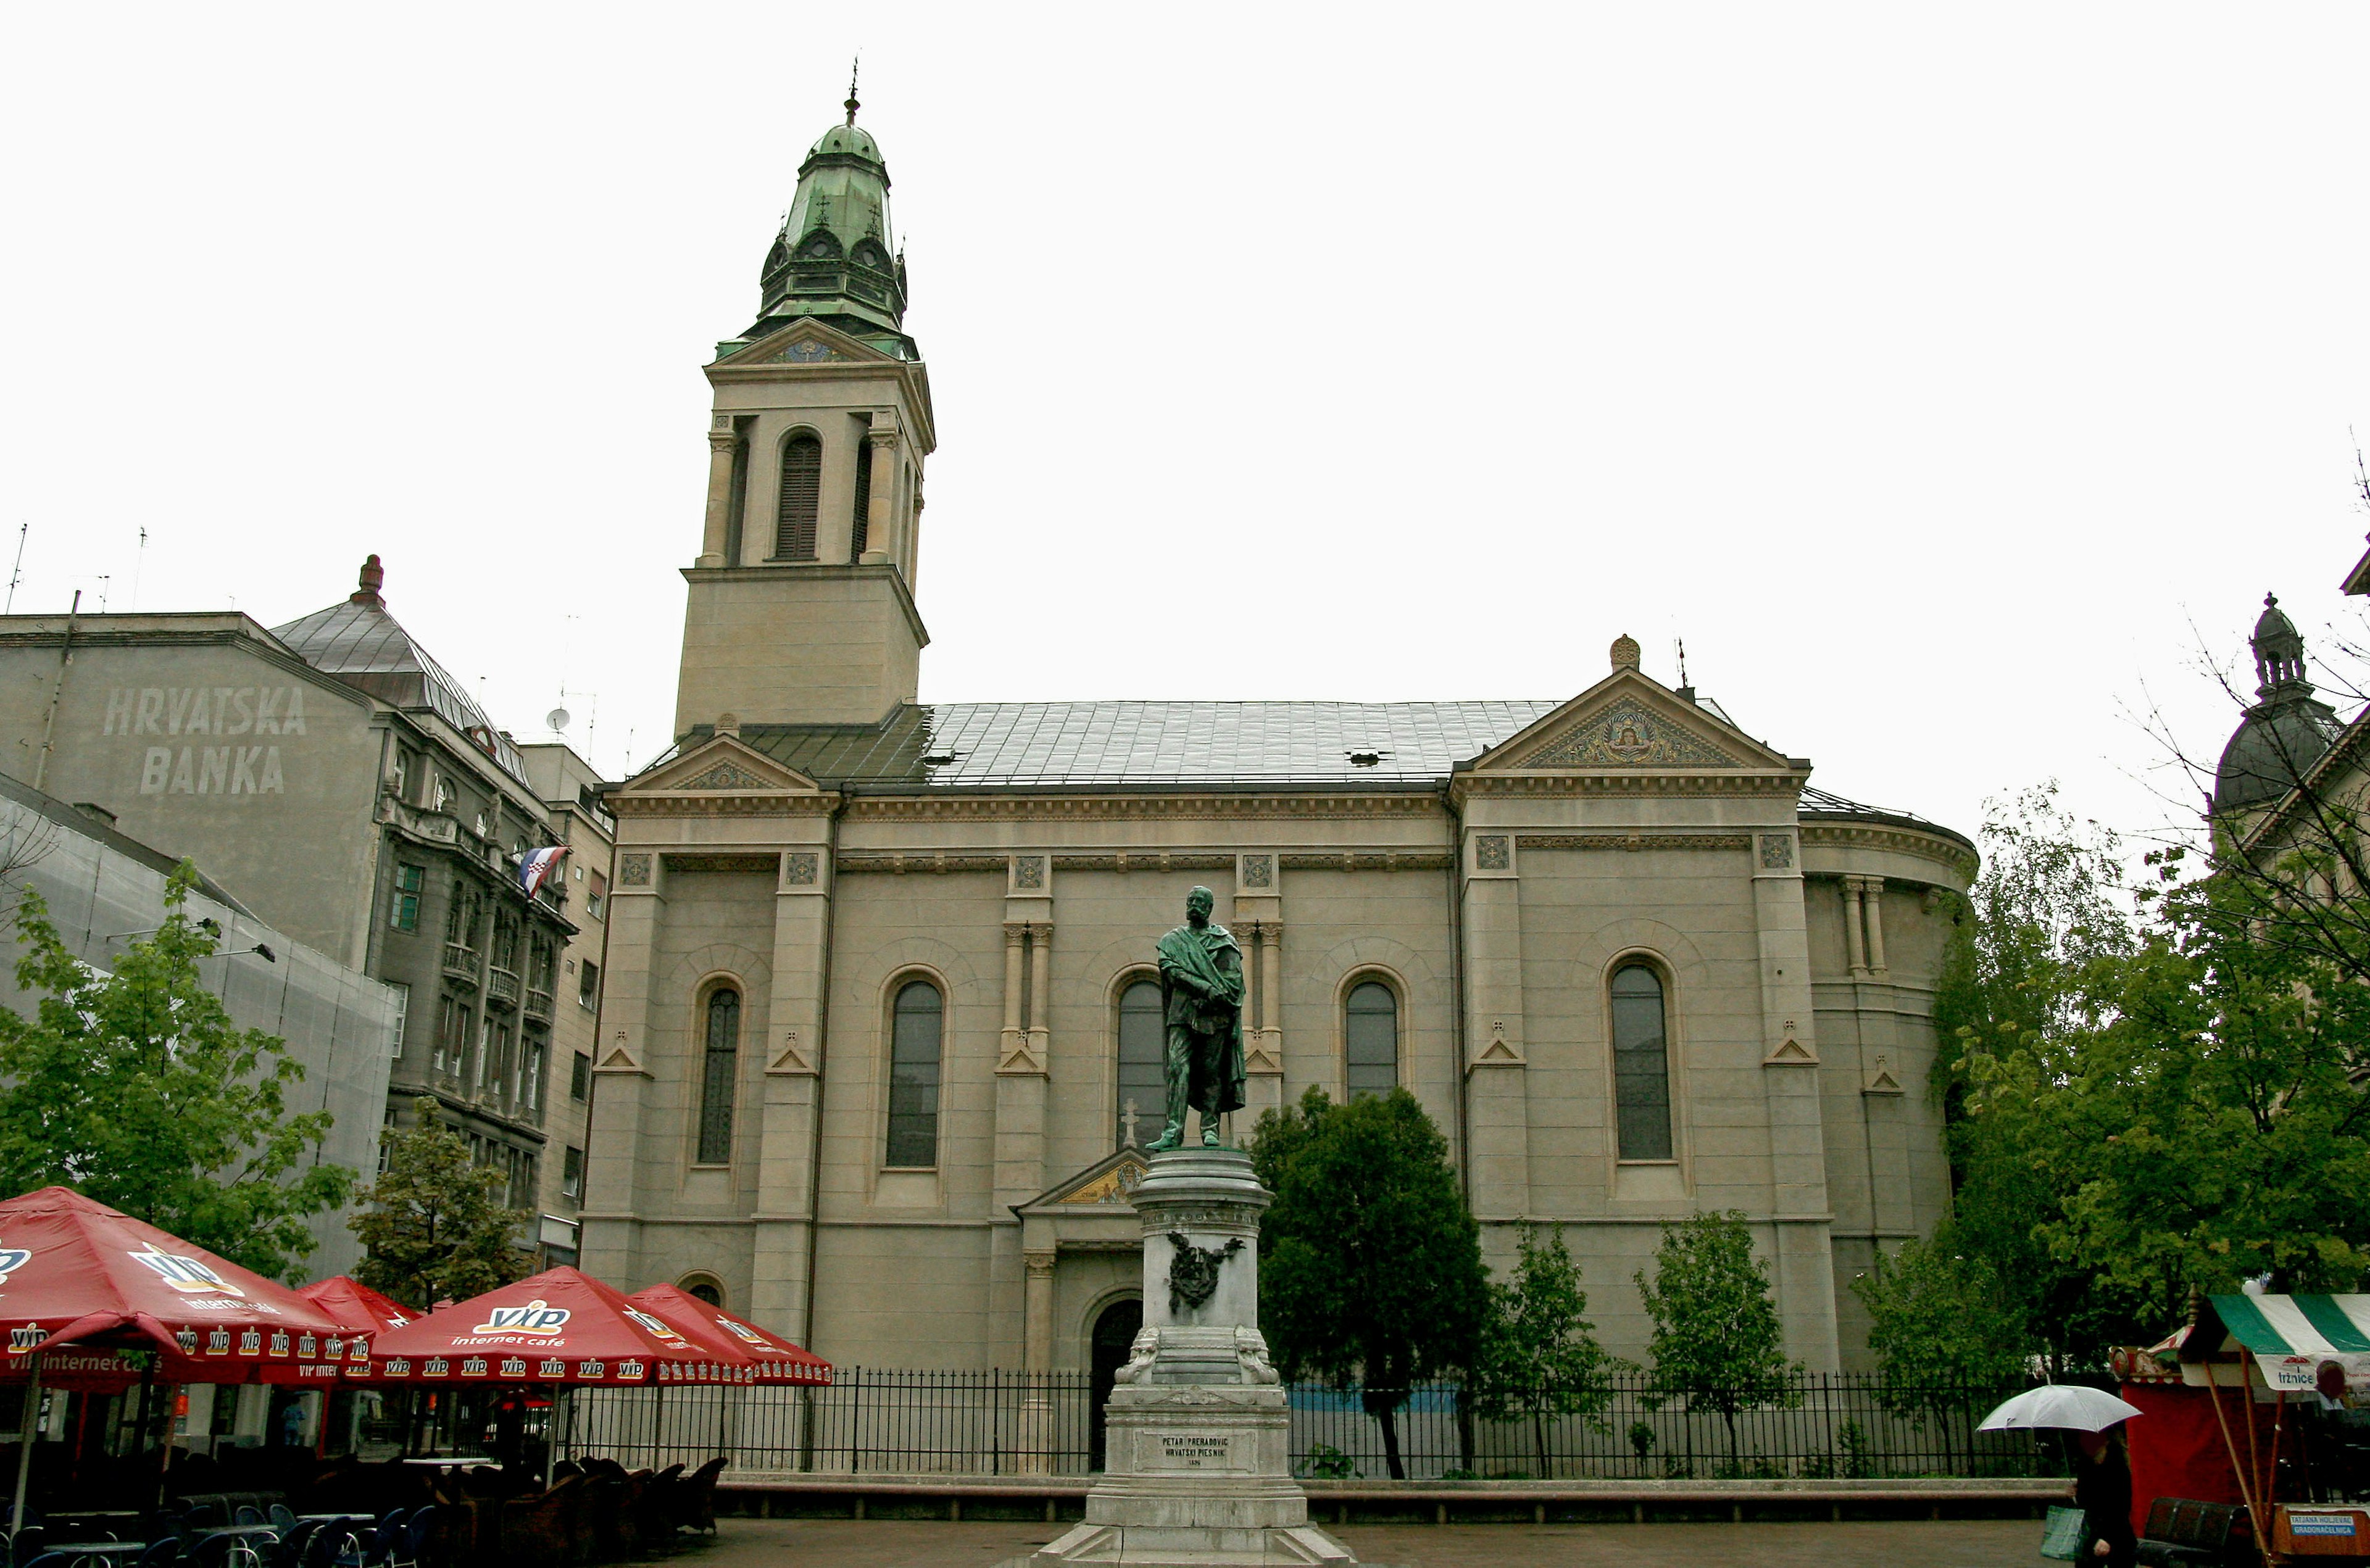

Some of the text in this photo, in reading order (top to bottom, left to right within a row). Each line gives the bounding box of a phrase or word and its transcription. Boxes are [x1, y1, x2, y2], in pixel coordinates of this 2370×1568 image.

[103, 686, 307, 736] HRVATSKA
[140, 746, 285, 794] BANKA
[493, 1301, 567, 1328] VIP
[451, 1336, 566, 1346] internet café
[43, 1352, 120, 1371] internet
[387, 1357, 410, 1372] VIP
[426, 1356, 448, 1372] VIP
[464, 1356, 486, 1372] VIP
[502, 1356, 525, 1372] VIP
[541, 1358, 564, 1374] VIP
[581, 1358, 604, 1374] VIP
[620, 1359, 642, 1375] VIP
[2279, 1371, 2313, 1383] tržnice
[1163, 1437, 1183, 1446] PETAR
[1165, 1448, 1196, 1456] HRVATSKI
